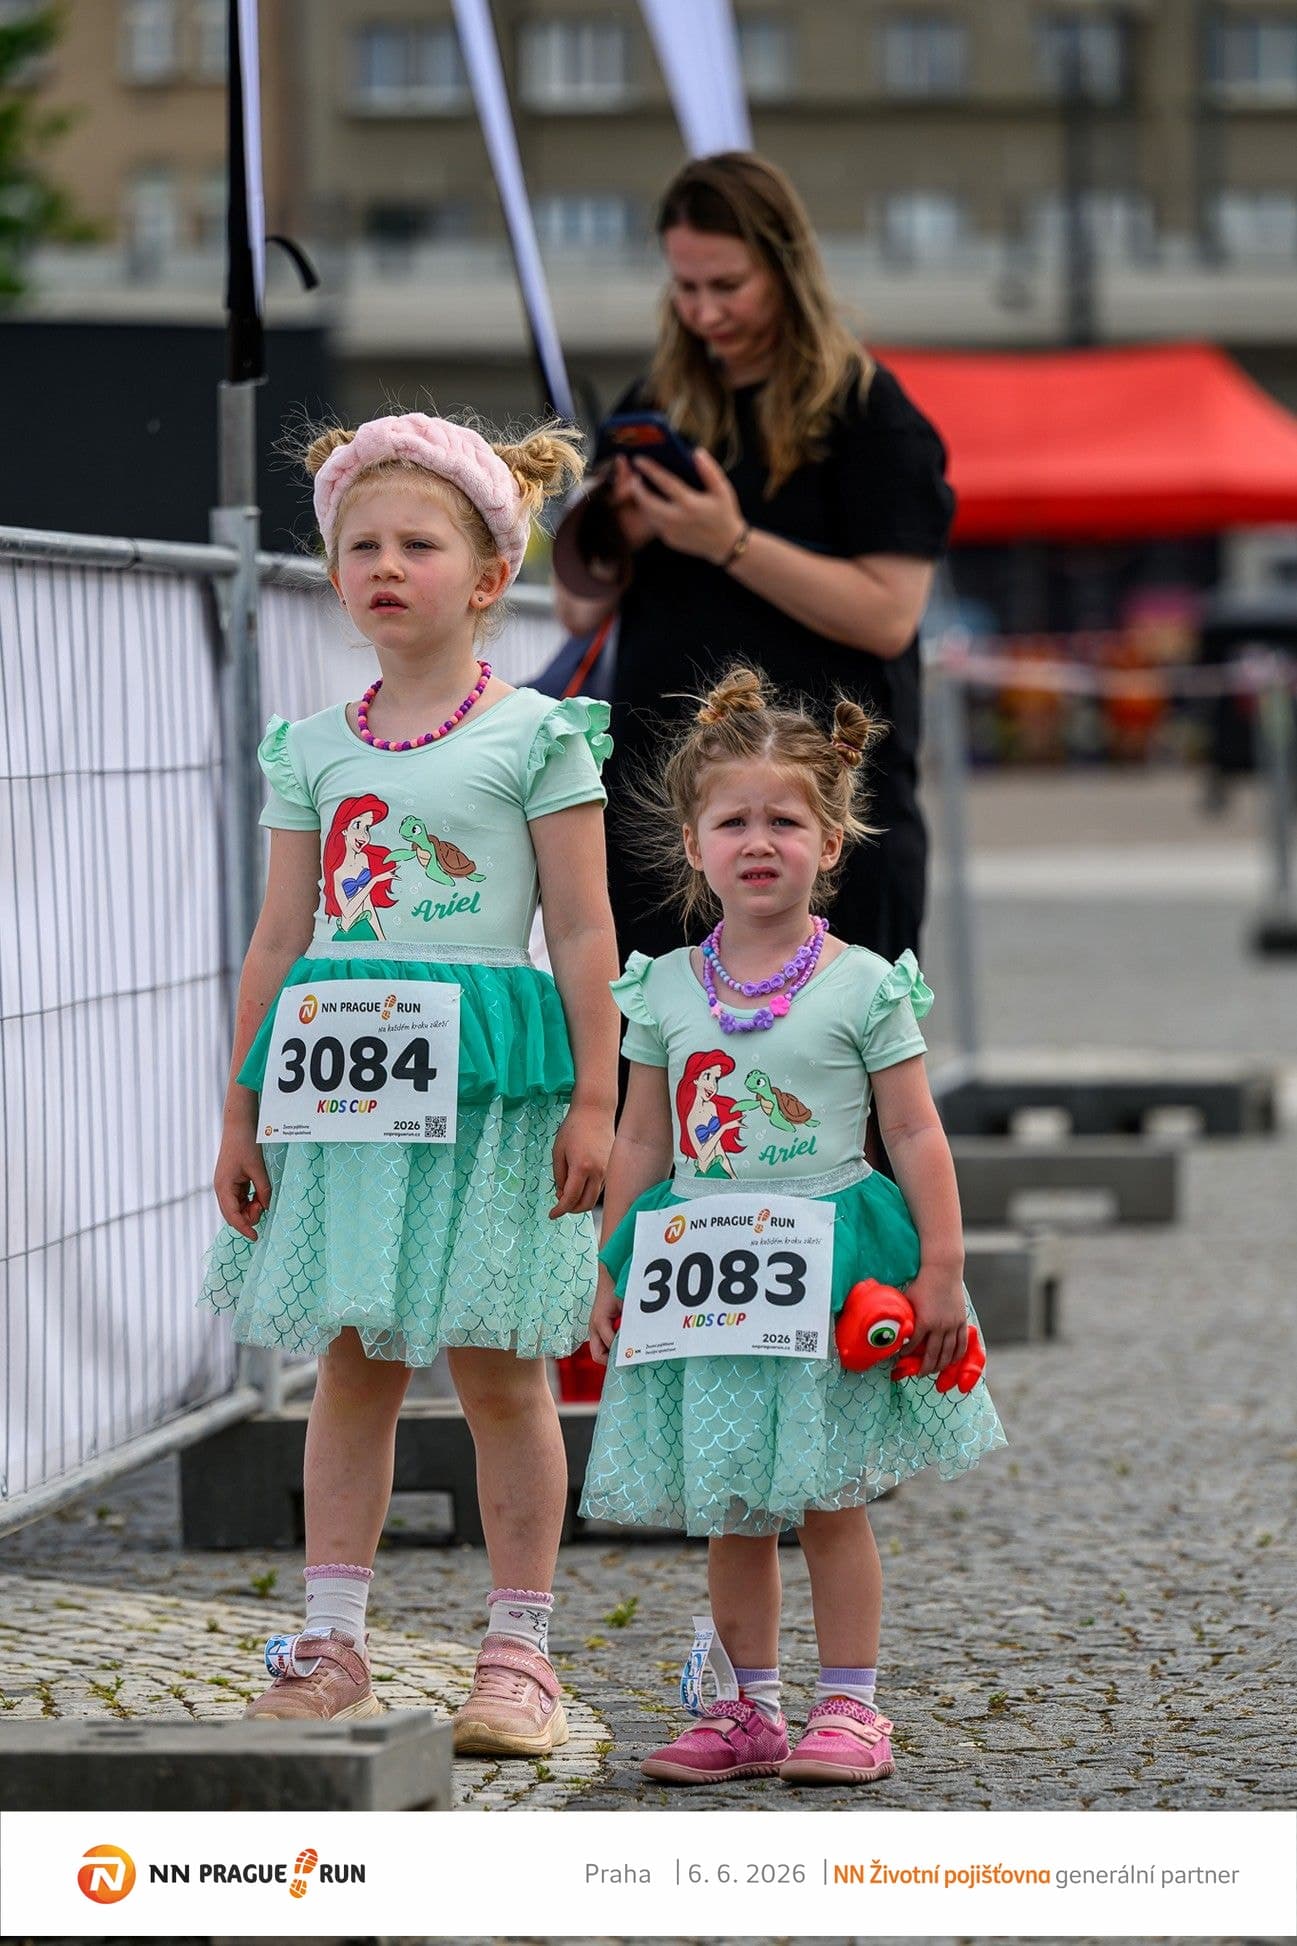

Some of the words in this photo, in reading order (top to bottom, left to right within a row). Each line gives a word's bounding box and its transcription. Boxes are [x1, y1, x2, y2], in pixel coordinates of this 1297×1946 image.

[411, 891, 481, 922] Ariel
[321, 1002, 337, 1013] NN
[340, 1001, 381, 1013] PRAGUE
[397, 1002, 421, 1013] RUN
[278, 1036, 437, 1094] 3084
[317, 1099, 347, 1113] KIDS
[350, 1099, 378, 1113] CUP
[393, 1120, 421, 1131] 2026
[759, 1136, 818, 1165] Ariel
[690, 1219, 708, 1230] NN
[710, 1216, 754, 1227] PRAGUE
[770, 1217, 795, 1229] RUN
[640, 1249, 807, 1314] 3083
[682, 1312, 715, 1329] KIDS
[716, 1312, 747, 1327] CUP
[762, 1333, 791, 1344] 2026
